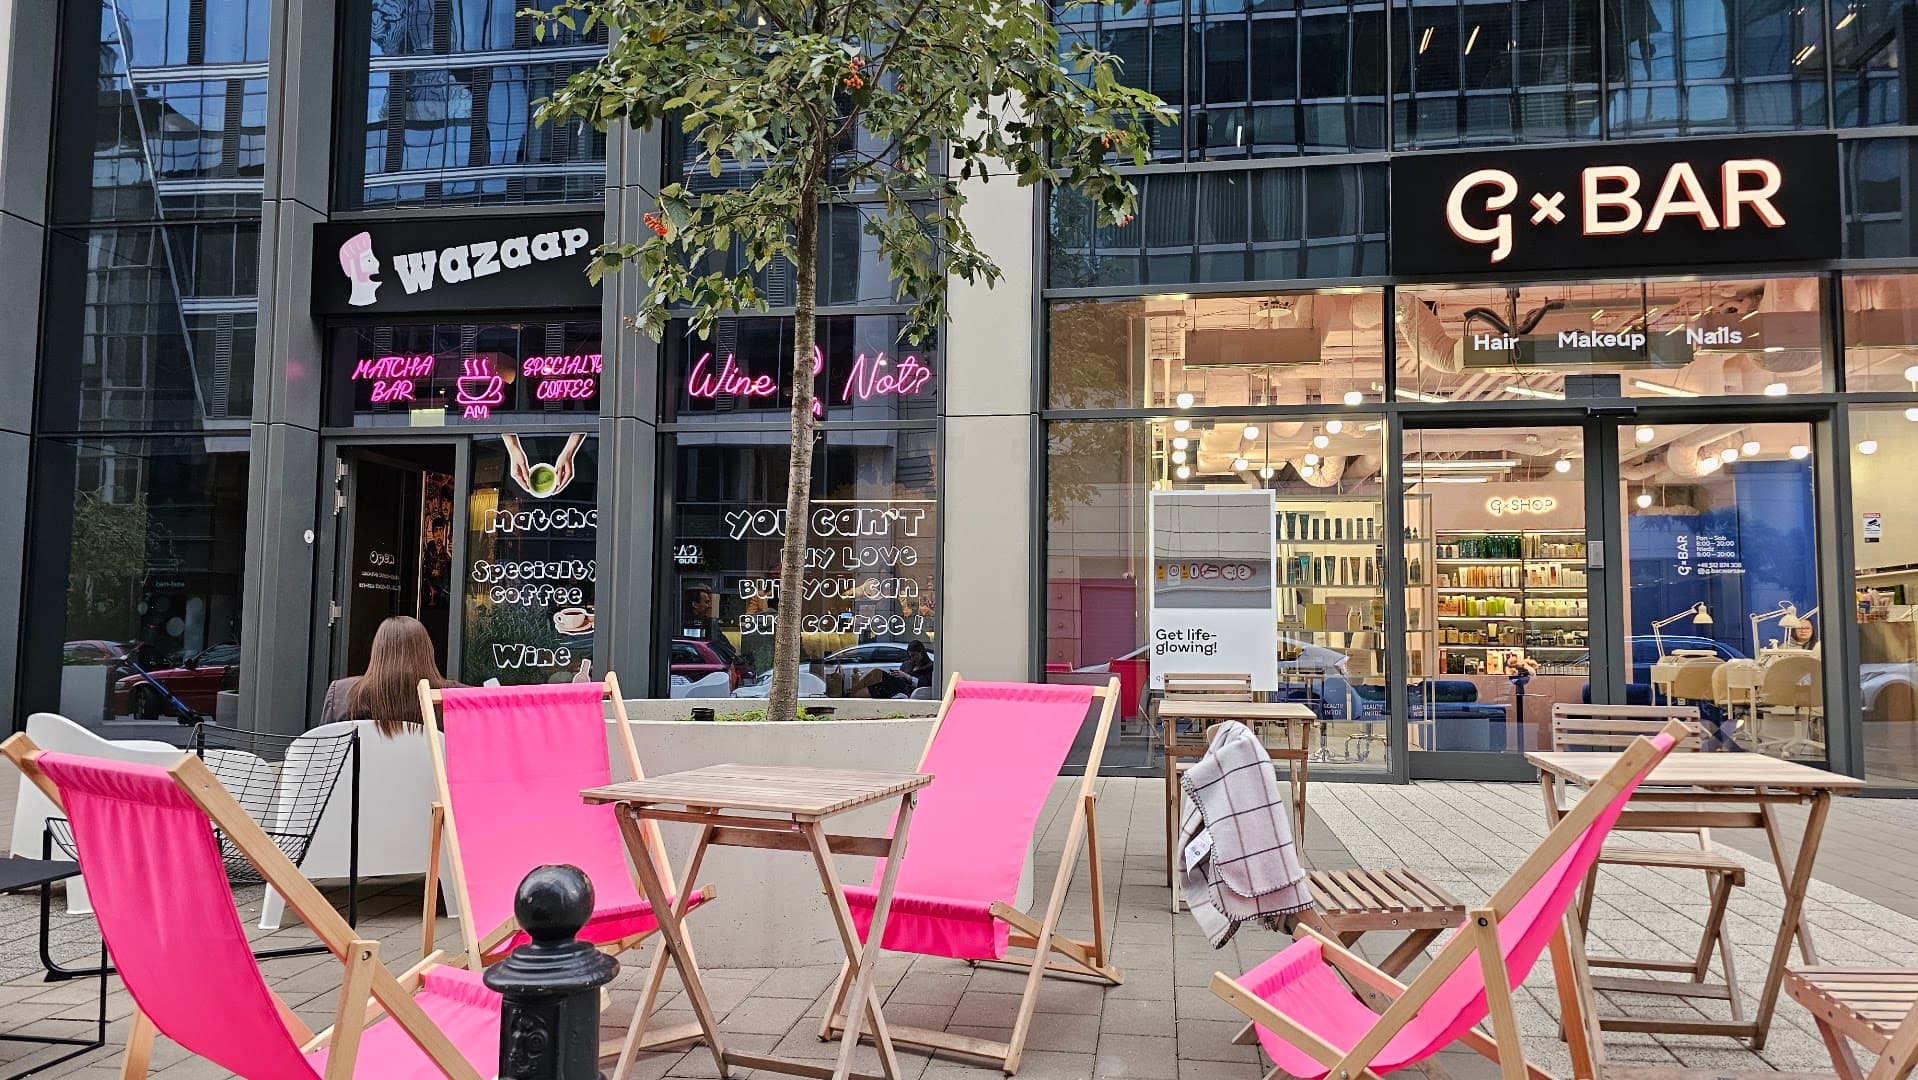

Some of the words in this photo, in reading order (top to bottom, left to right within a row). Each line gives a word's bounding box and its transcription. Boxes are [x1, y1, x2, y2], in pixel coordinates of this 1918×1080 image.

[1473, 333, 1520, 351] Hair
[1558, 330, 1646, 350] Makeup
[1686, 327, 1743, 346] Nails
[351, 355, 434, 380] MATCHA
[688, 352, 777, 398] Wine
[842, 352, 931, 401] Not?
[371, 380, 415, 402] BAR
[536, 379, 594, 400] COFFEE
[463, 405, 489, 419] AM
[370, 550, 395, 566] Open
[489, 584, 583, 606] Coffee
[738, 614, 779, 635] BU
[1156, 628, 1184, 641] Get
[1187, 628, 1217, 641] life-
[492, 643, 571, 668] Wine
[1156, 640, 1217, 656] glowing!
